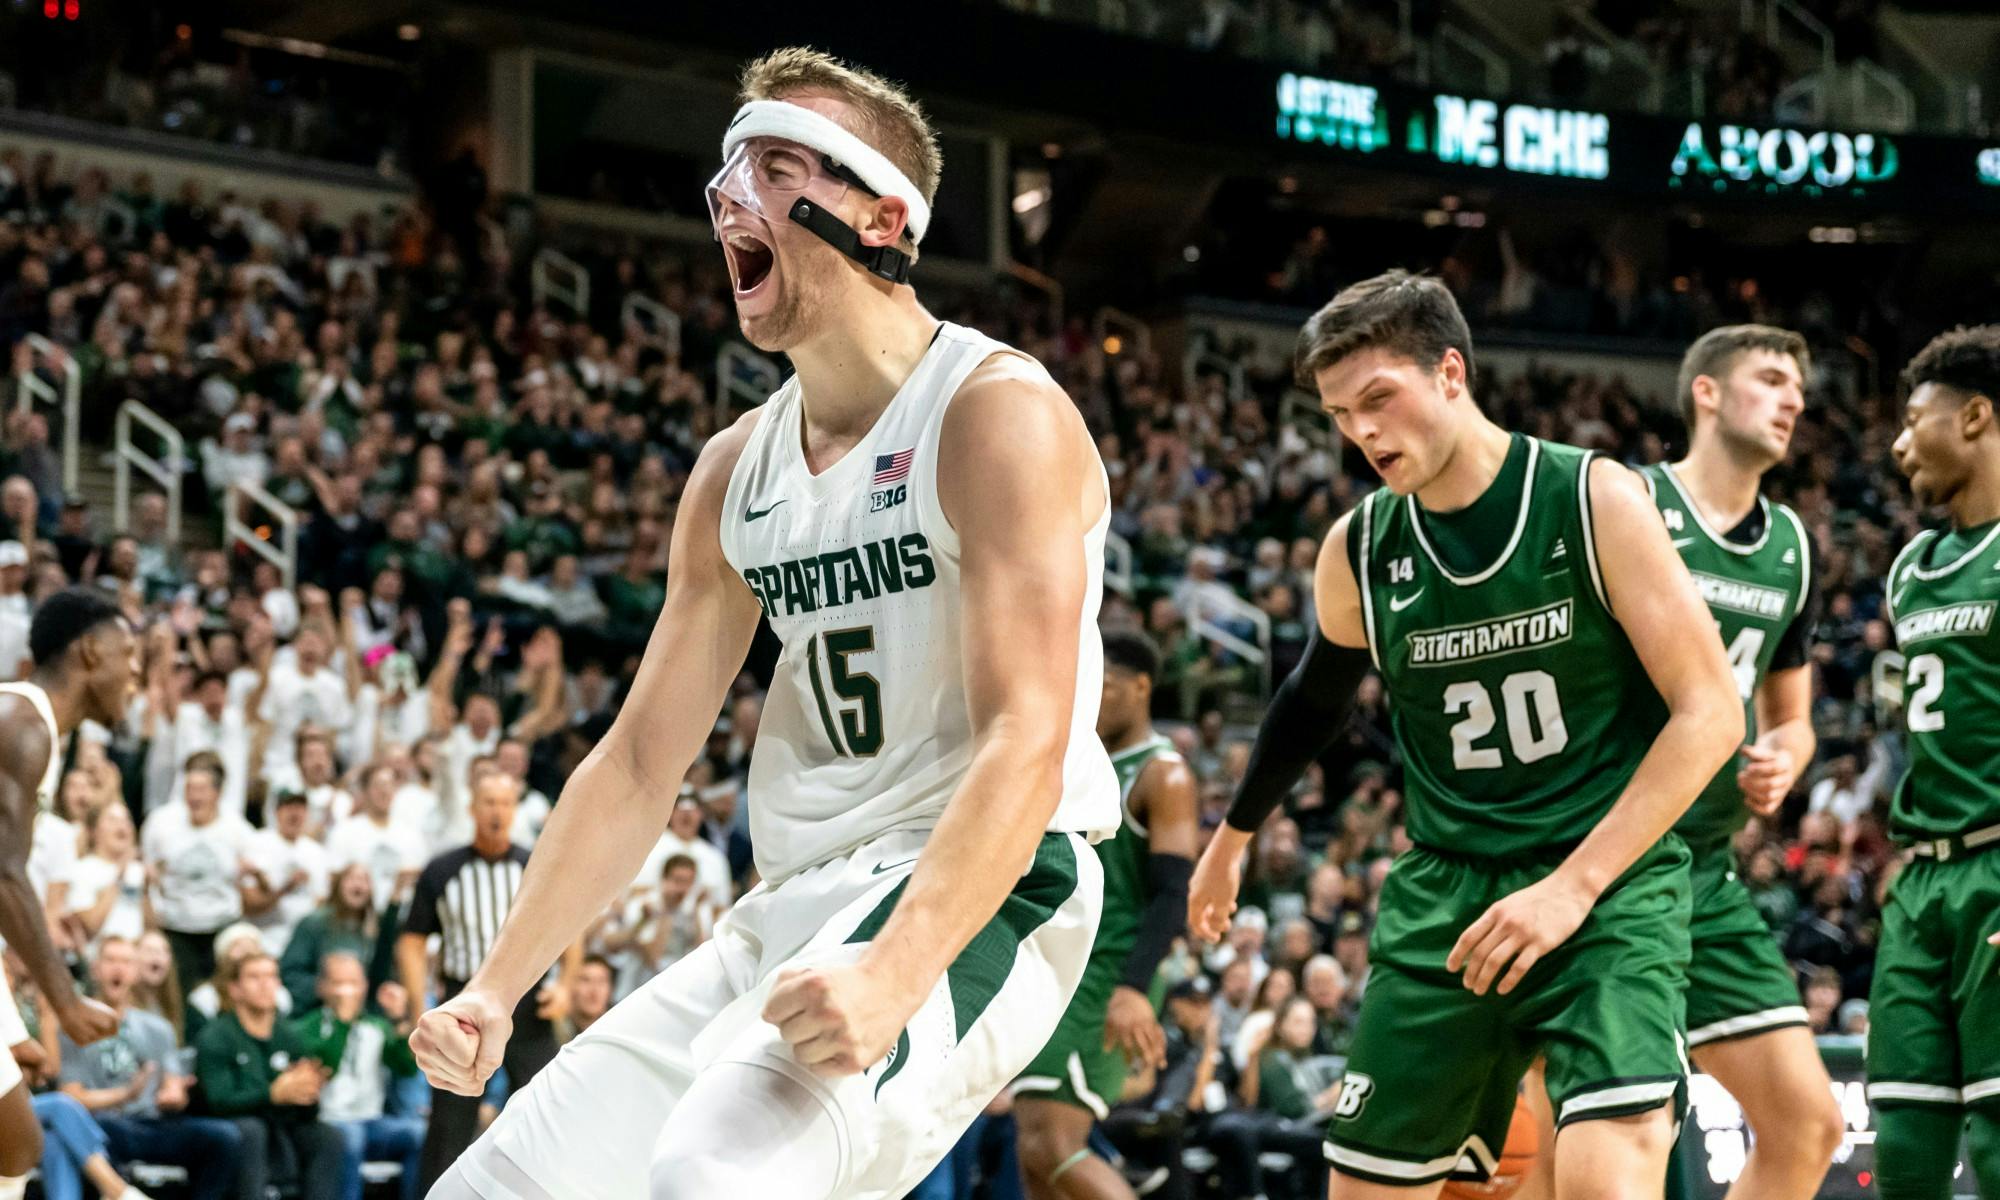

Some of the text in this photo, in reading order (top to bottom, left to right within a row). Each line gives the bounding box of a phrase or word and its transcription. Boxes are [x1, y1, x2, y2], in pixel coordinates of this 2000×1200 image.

[744, 532, 936, 618] SPARTANS
[1387, 556, 1414, 584] 14
[1412, 605, 1568, 662] BINGHAMTON
[1715, 620, 1766, 699] 4
[807, 625, 885, 758] 15
[1443, 669, 1569, 770] 20
[1906, 653, 1945, 733] 2
[1335, 1071, 1375, 1121] B
